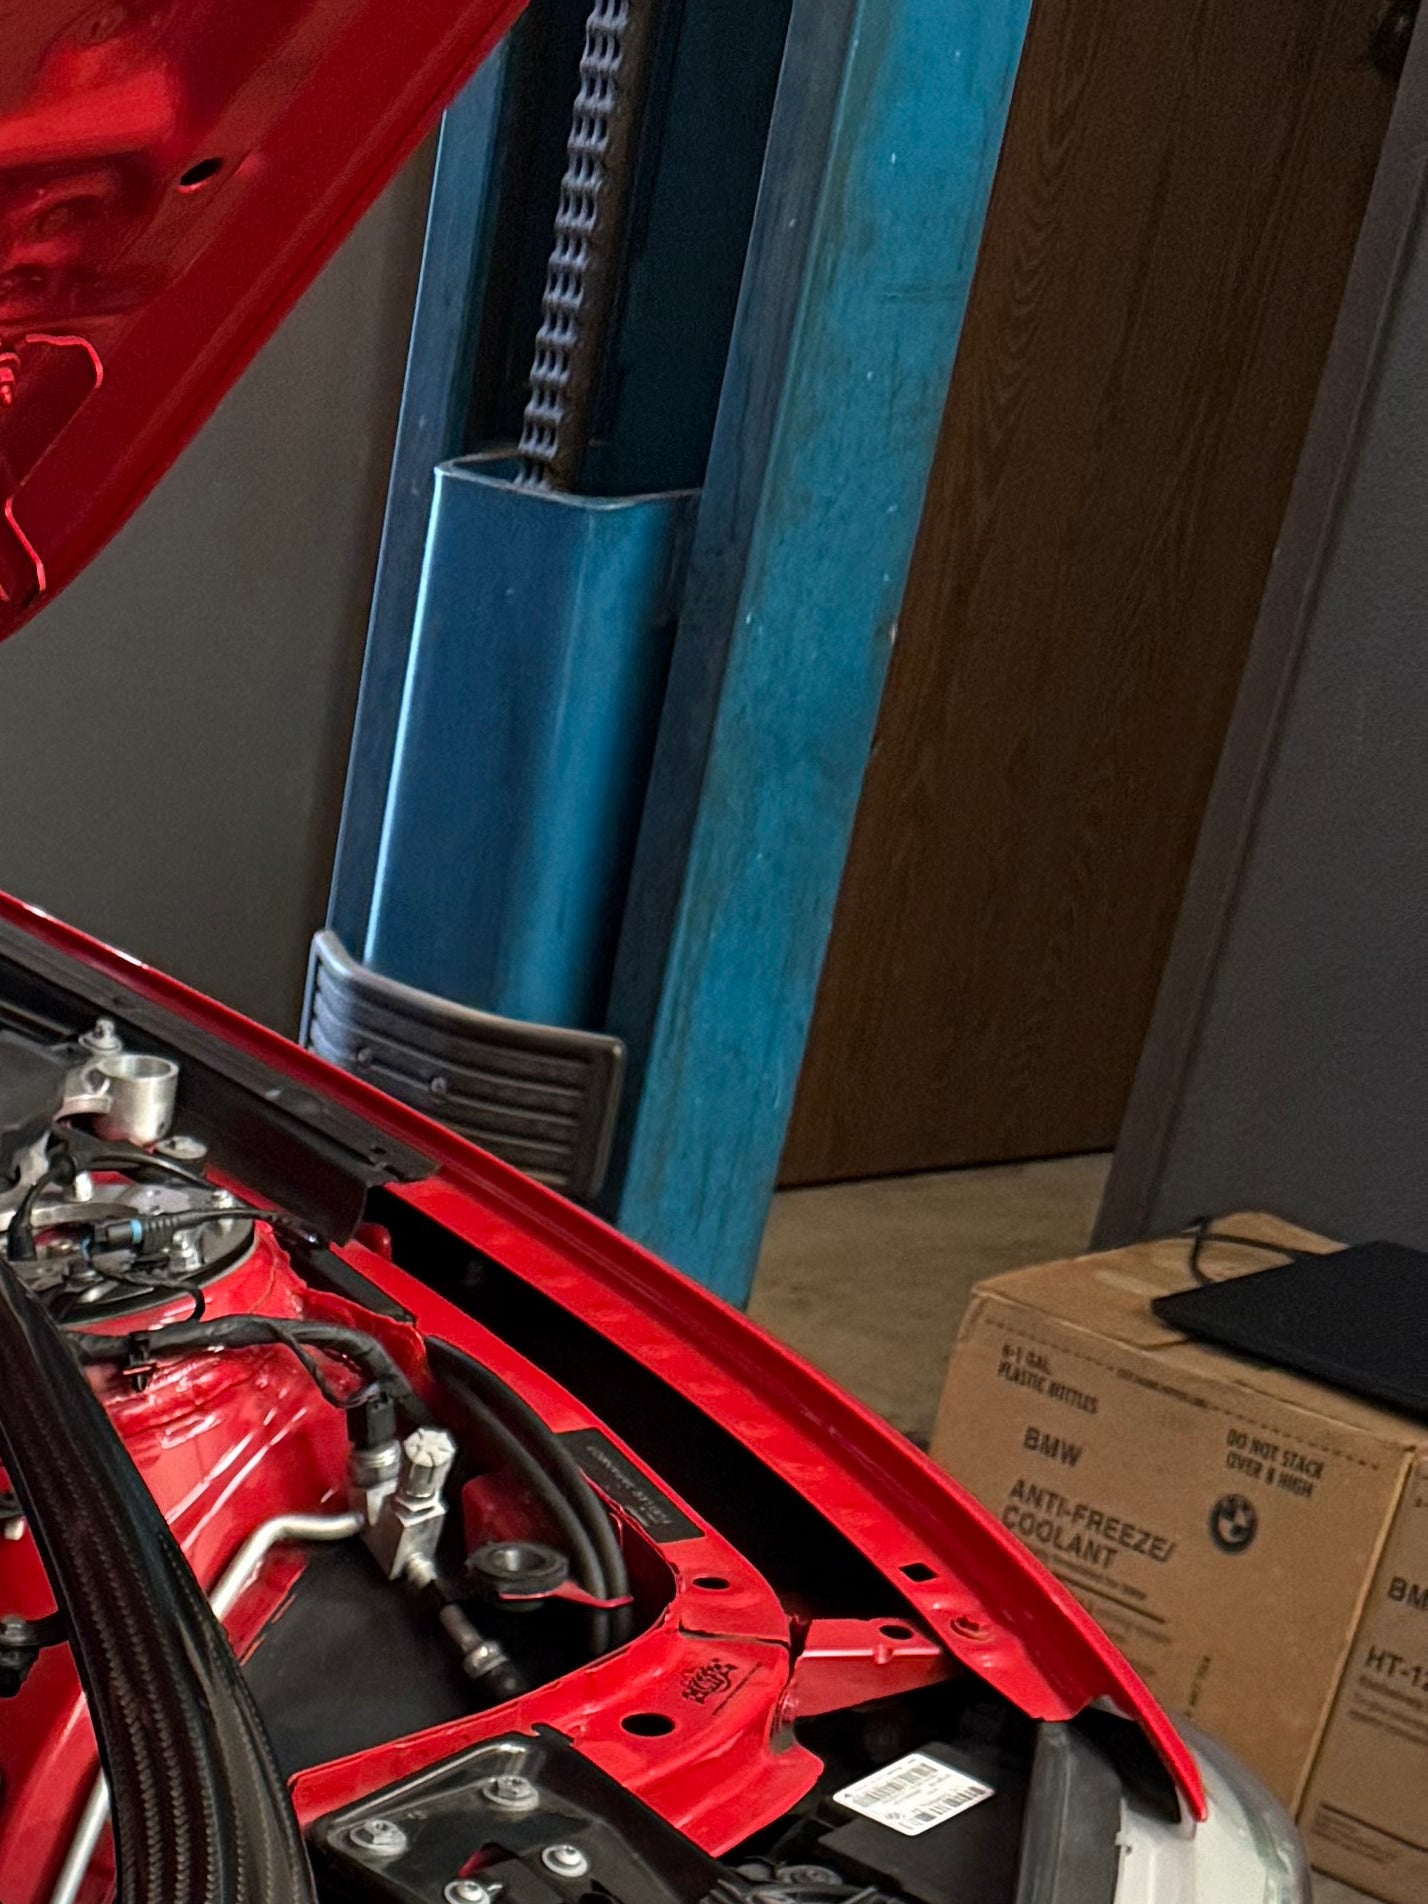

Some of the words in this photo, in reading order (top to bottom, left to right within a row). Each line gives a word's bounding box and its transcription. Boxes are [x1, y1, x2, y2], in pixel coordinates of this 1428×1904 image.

[998, 1360, 1046, 1393] PLASTIC
[1023, 1426, 1082, 1467] BMW
[1226, 1429, 1247, 1450] DO
[1249, 1438, 1279, 1461] NOT
[1282, 1449, 1324, 1479] STACK
[1226, 1450, 1263, 1478] OVER
[1277, 1470, 1314, 1498] HIGH
[1002, 1505, 1117, 1569] COOLANT
[1009, 1480, 1177, 1562] ANTI-FREEZE/
